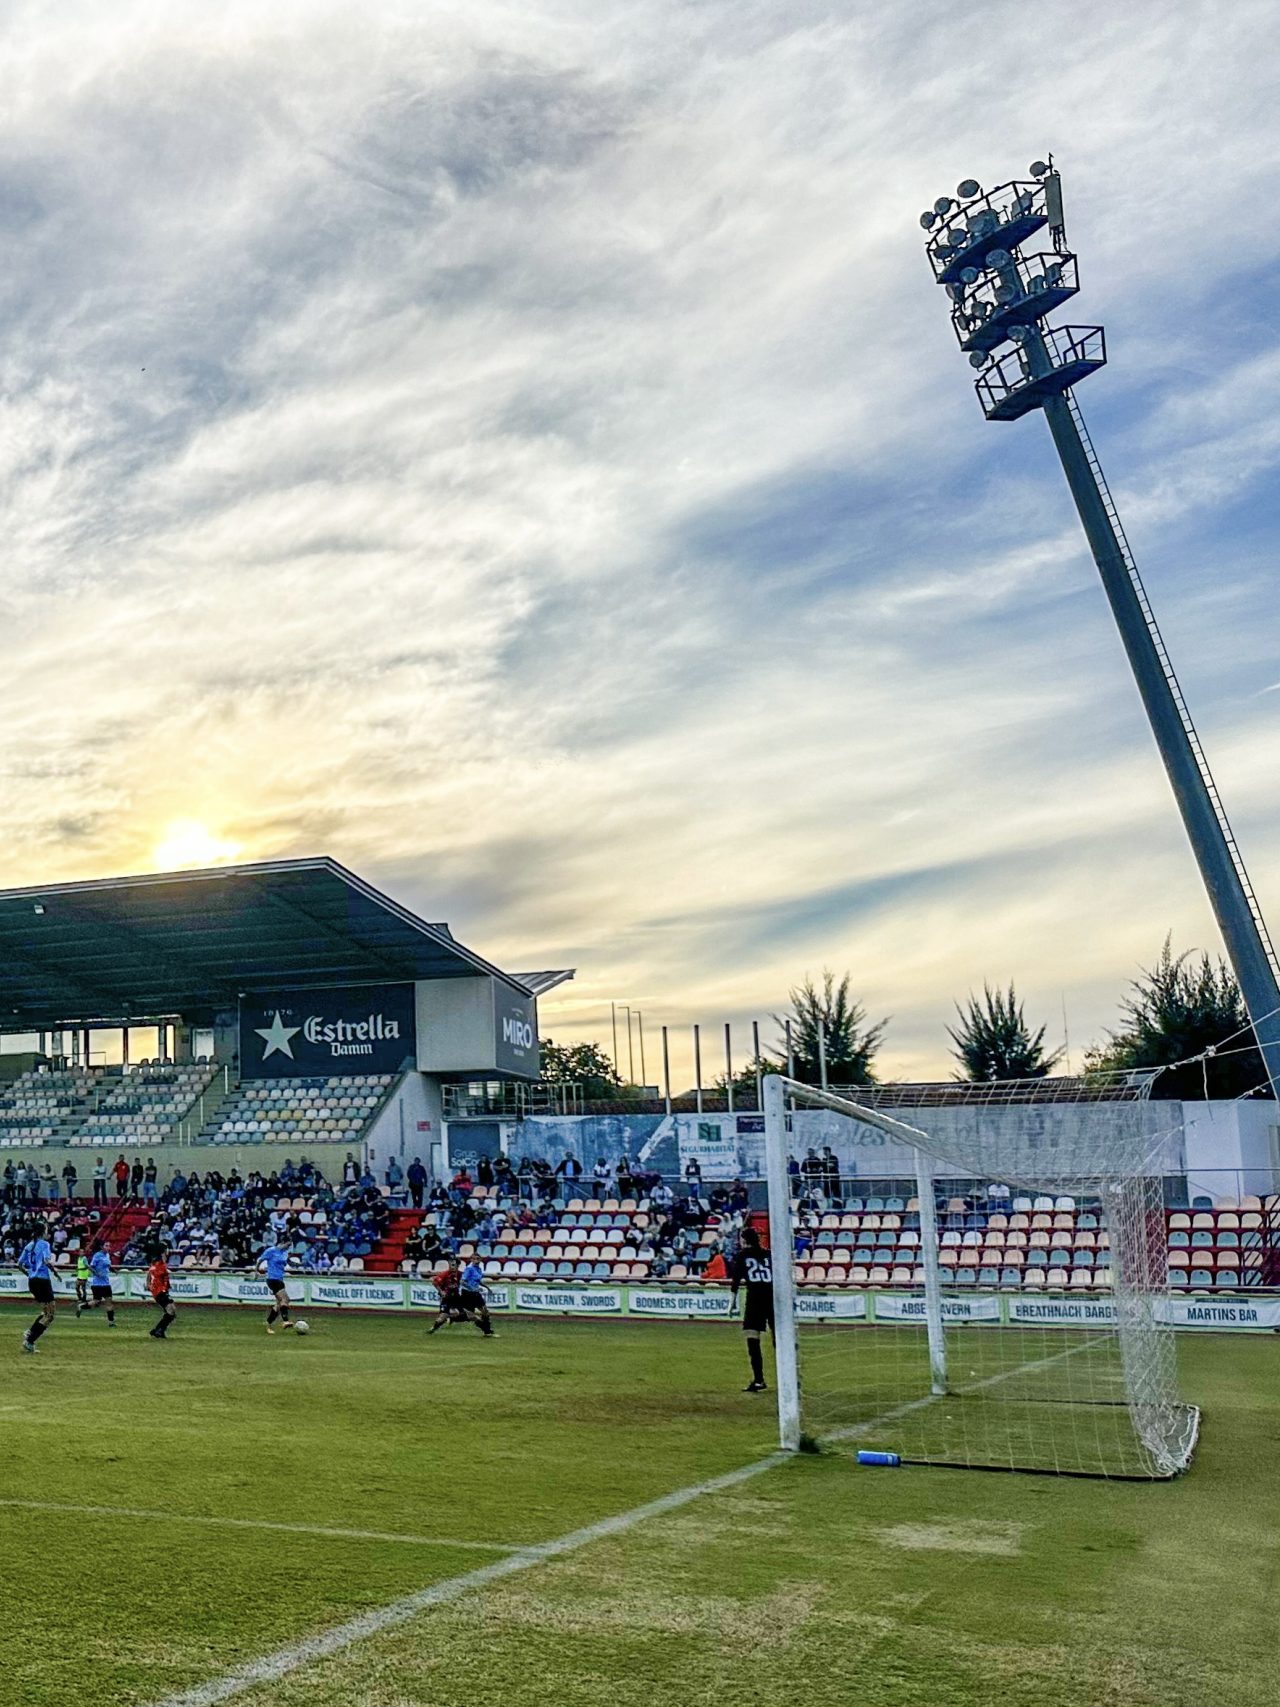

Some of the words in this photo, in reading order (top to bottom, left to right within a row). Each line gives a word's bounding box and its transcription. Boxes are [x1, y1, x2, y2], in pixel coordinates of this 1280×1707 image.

[303, 1013, 400, 1044] Estrella
[329, 1042, 373, 1057] Damm
[319, 1287, 350, 1299] PARNELL
[351, 1288, 363, 1299] OFF
[365, 1288, 395, 1300] LICENCE
[412, 1290, 427, 1300] THE
[482, 1292, 506, 1304] TREET
[521, 1293, 543, 1305] COCK
[544, 1294, 575, 1306] TAVERN
[581, 1295, 616, 1307] SWORDS
[635, 1296, 677, 1308] BOOMERS
[940, 1303, 971, 1316] AVERN
[1015, 1304, 1082, 1318] BREATHNACH
[1187, 1307, 1236, 1321] MARTINS
[1239, 1308, 1258, 1322] BAR
